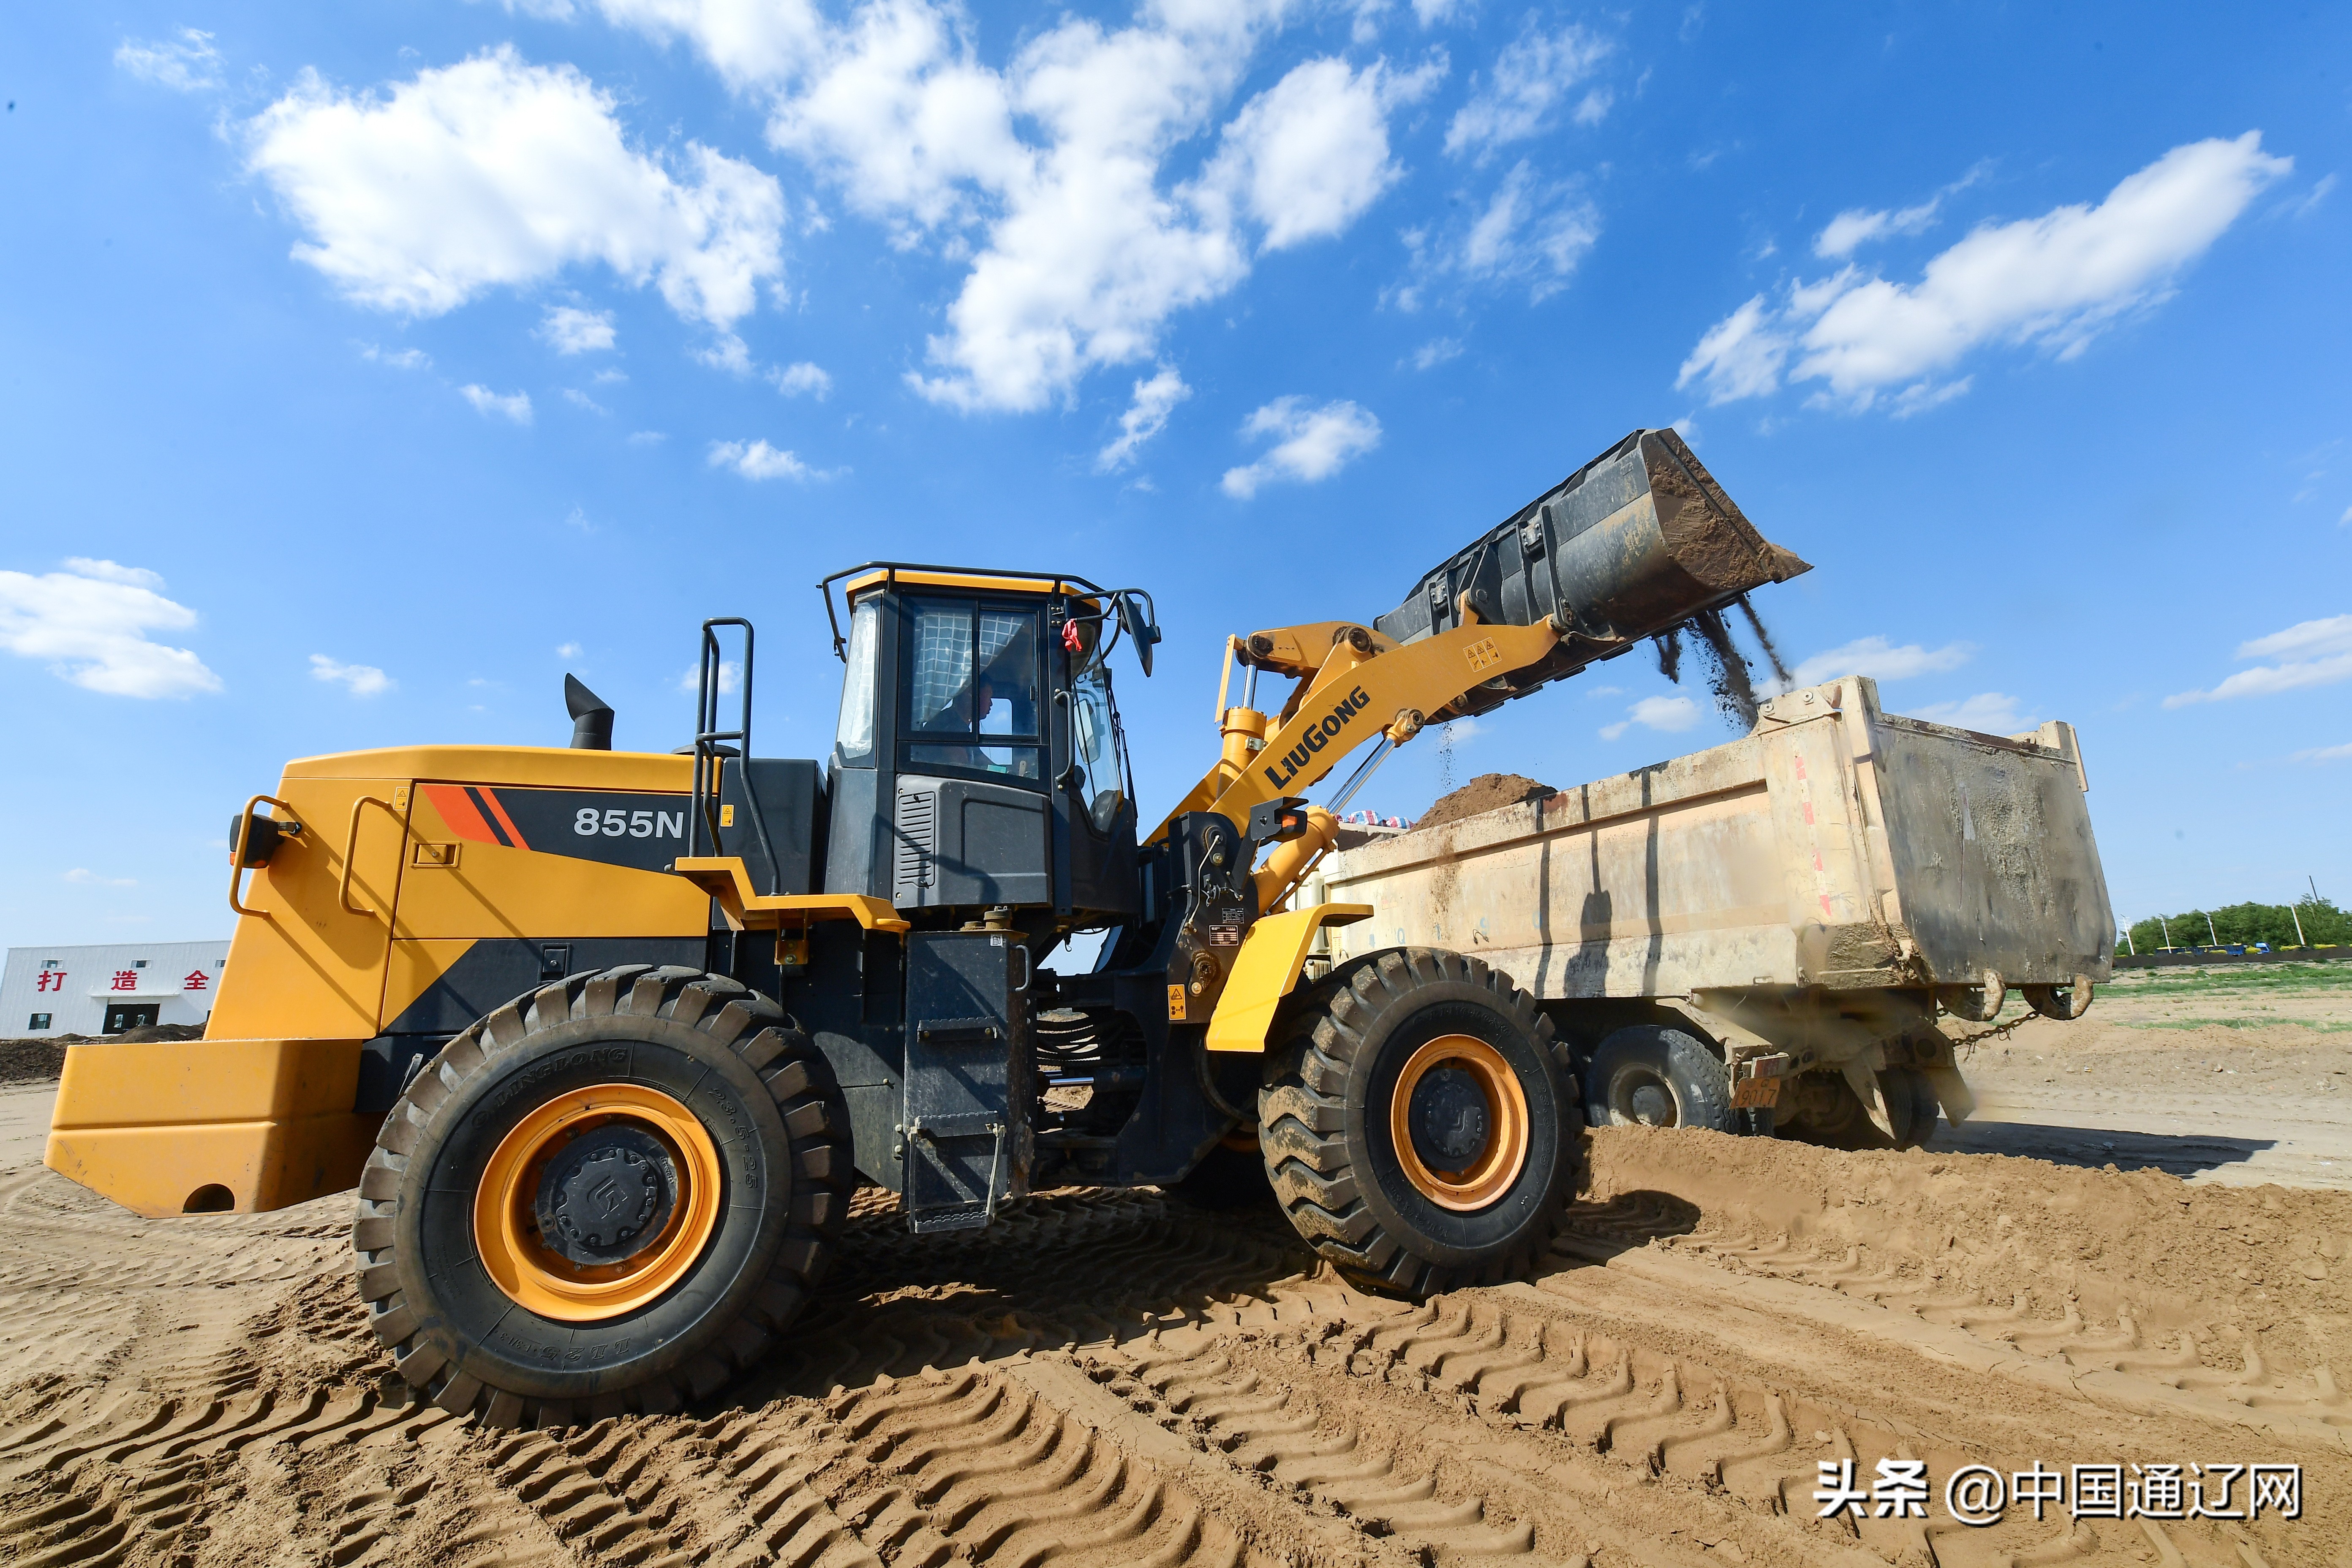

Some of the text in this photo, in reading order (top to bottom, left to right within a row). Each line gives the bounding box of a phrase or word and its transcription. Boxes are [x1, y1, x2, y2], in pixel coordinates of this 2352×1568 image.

[574, 808, 684, 839] 855N
[37, 969, 210, 992] 打造全
[495, 1048, 627, 1107] LINGLONG
[1734, 1089, 1777, 1107] 19017
[708, 1088, 758, 1188] 23.5-25
